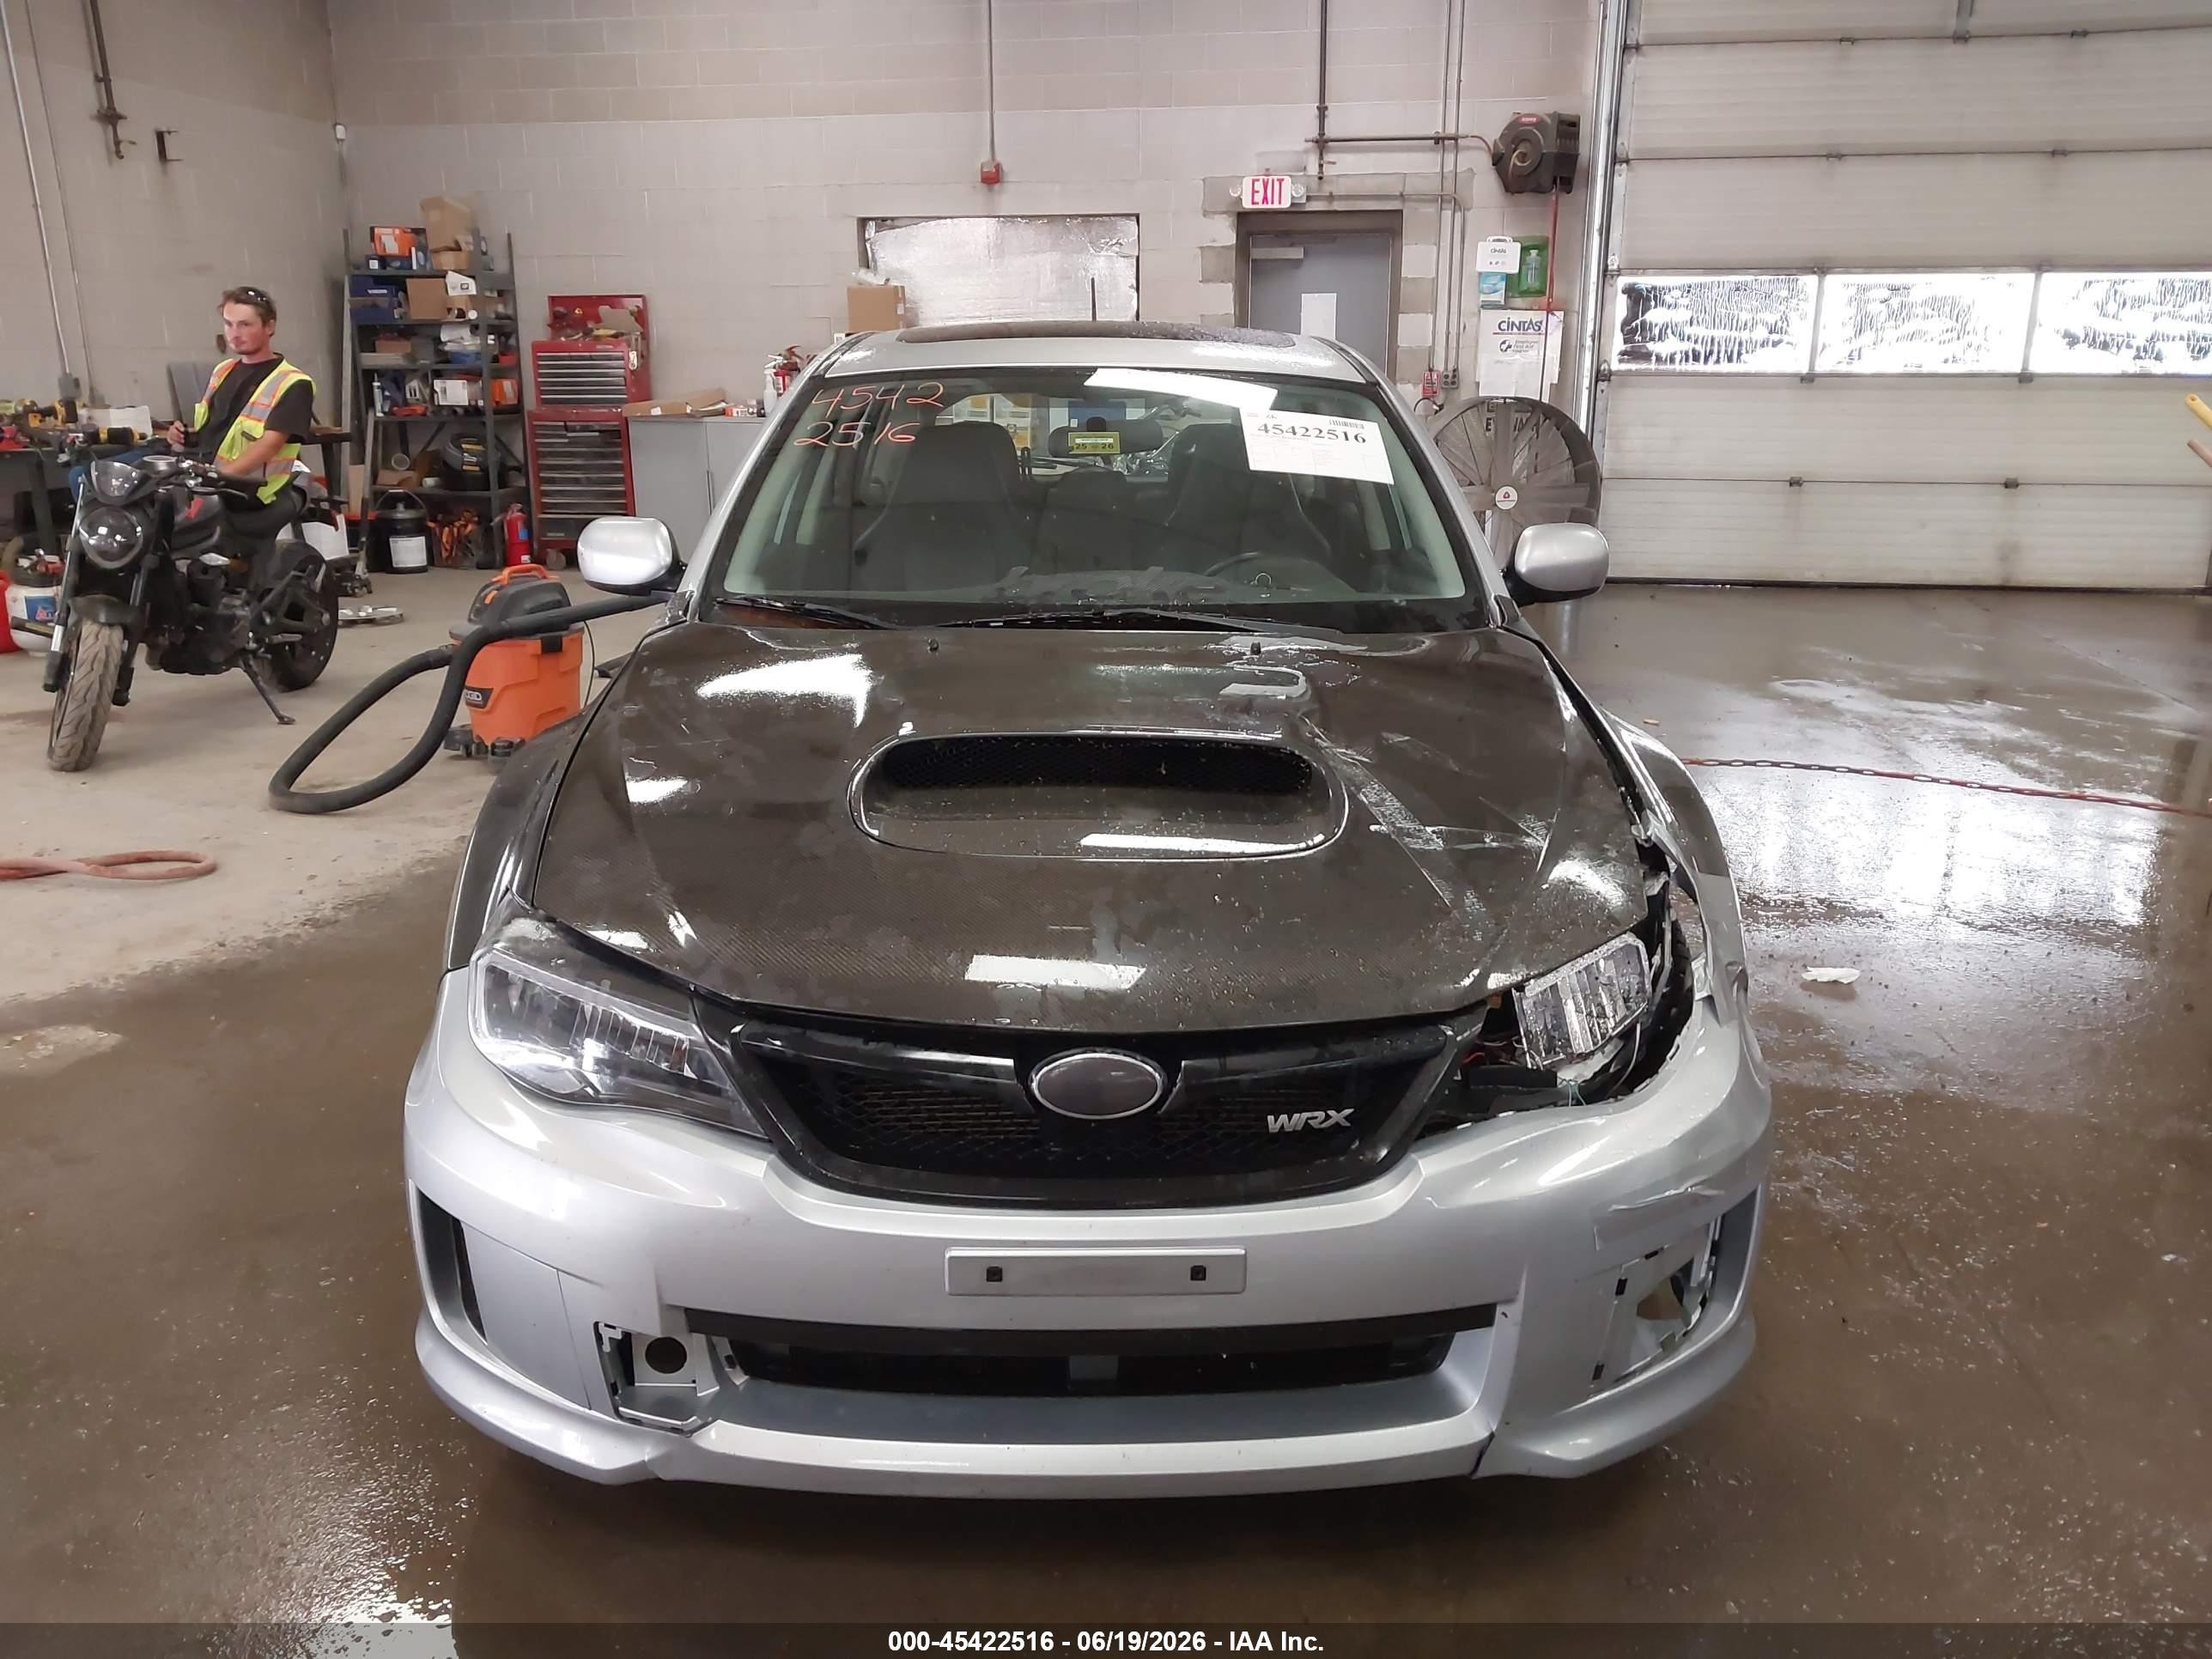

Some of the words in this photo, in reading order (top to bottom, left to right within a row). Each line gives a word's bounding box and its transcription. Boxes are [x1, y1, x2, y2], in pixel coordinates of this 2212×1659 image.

[1251, 178, 1285, 205] EXIT
[1498, 316, 1543, 332] CINTAS
[811, 381, 945, 419] 4542
[793, 420, 922, 447] 2516
[1257, 422, 1367, 445] 45422516
[1267, 1108, 1355, 1133] WRX
